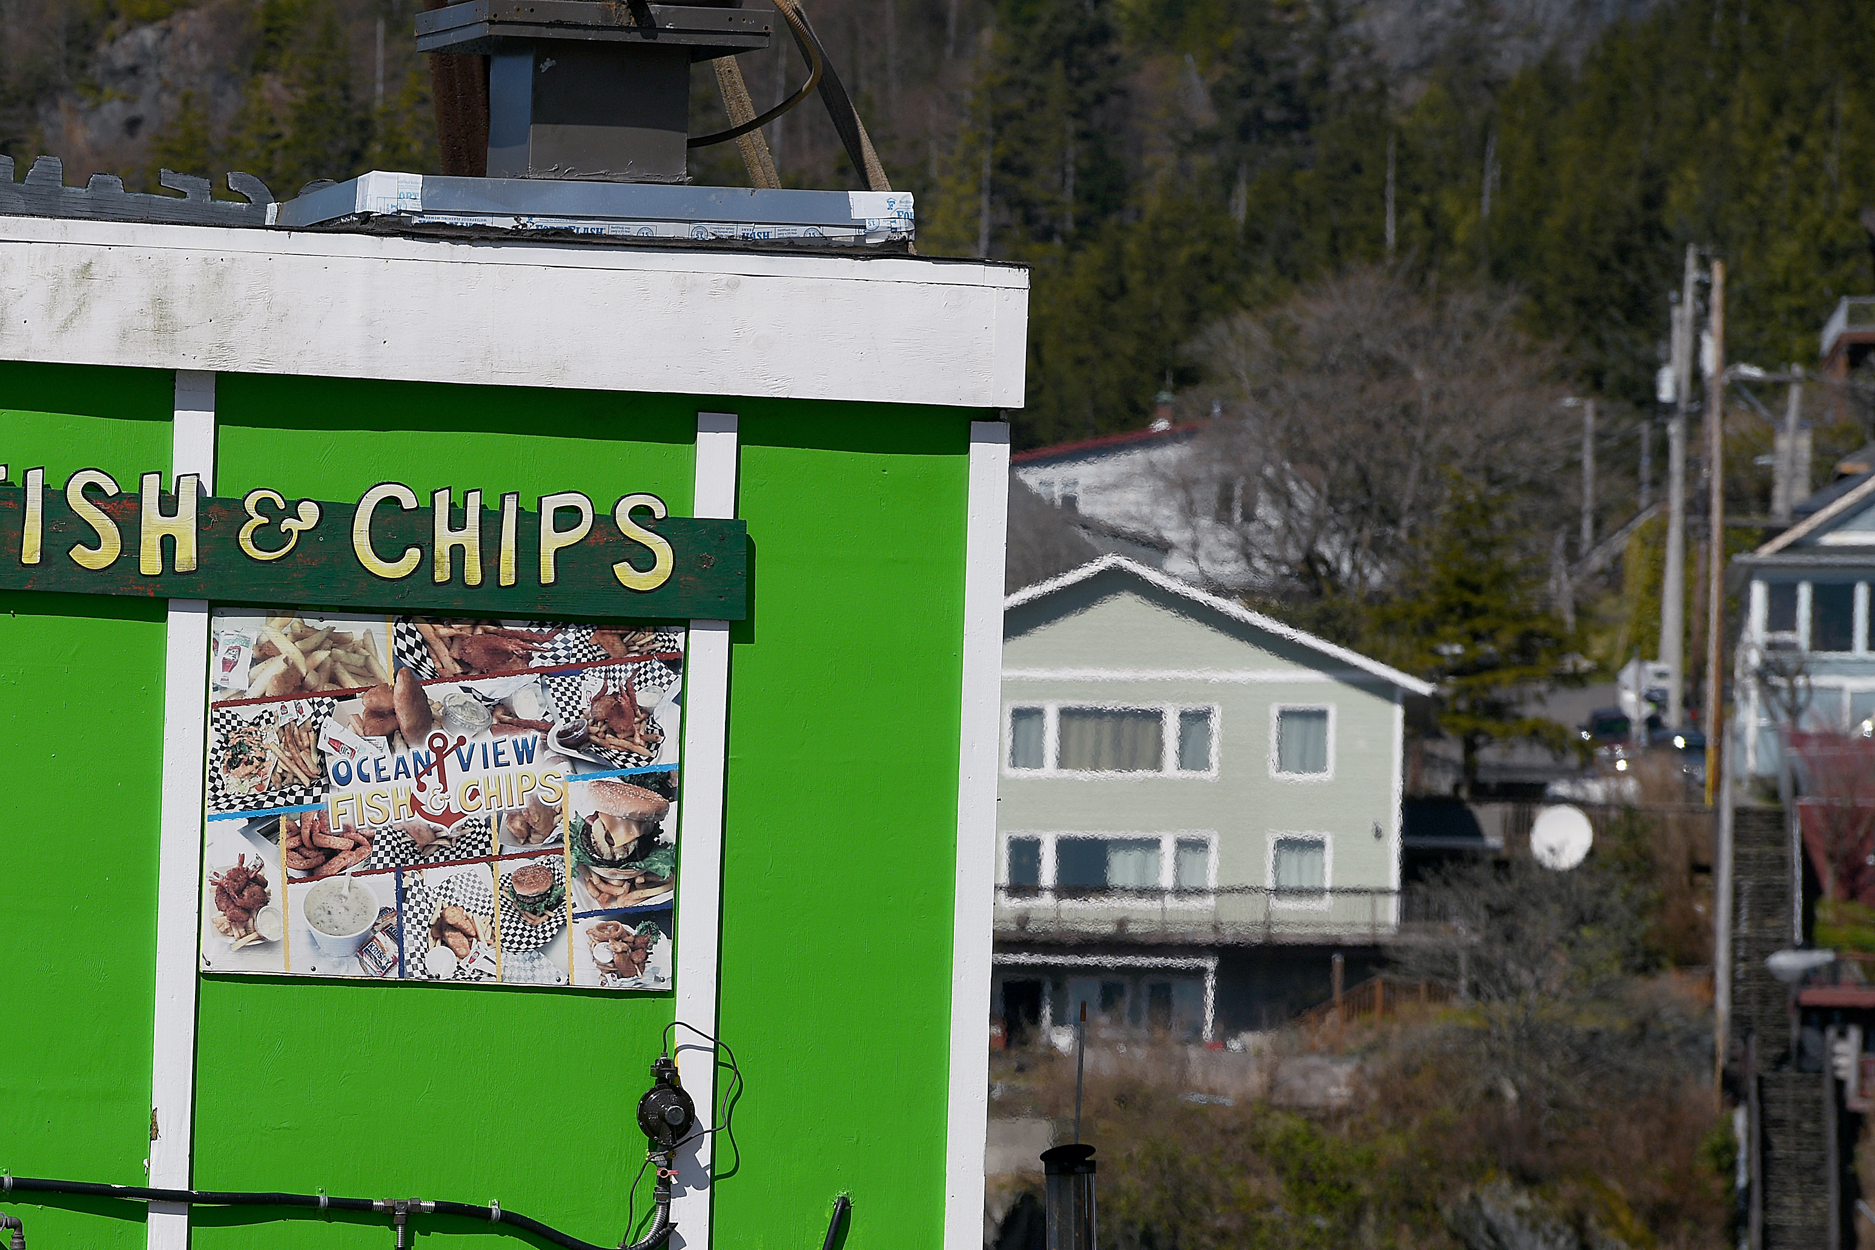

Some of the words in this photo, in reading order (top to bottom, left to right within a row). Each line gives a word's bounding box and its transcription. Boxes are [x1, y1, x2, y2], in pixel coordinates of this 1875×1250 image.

[237, 487, 320, 563] &
[351, 481, 675, 593] CHIPS
[331, 750, 432, 787] OCEAN
[456, 734, 539, 773] VIEW
[329, 786, 415, 831] FISH
[429, 786, 451, 811] &
[459, 771, 564, 813] CHIPS
[367, 942, 392, 967] KRISY
